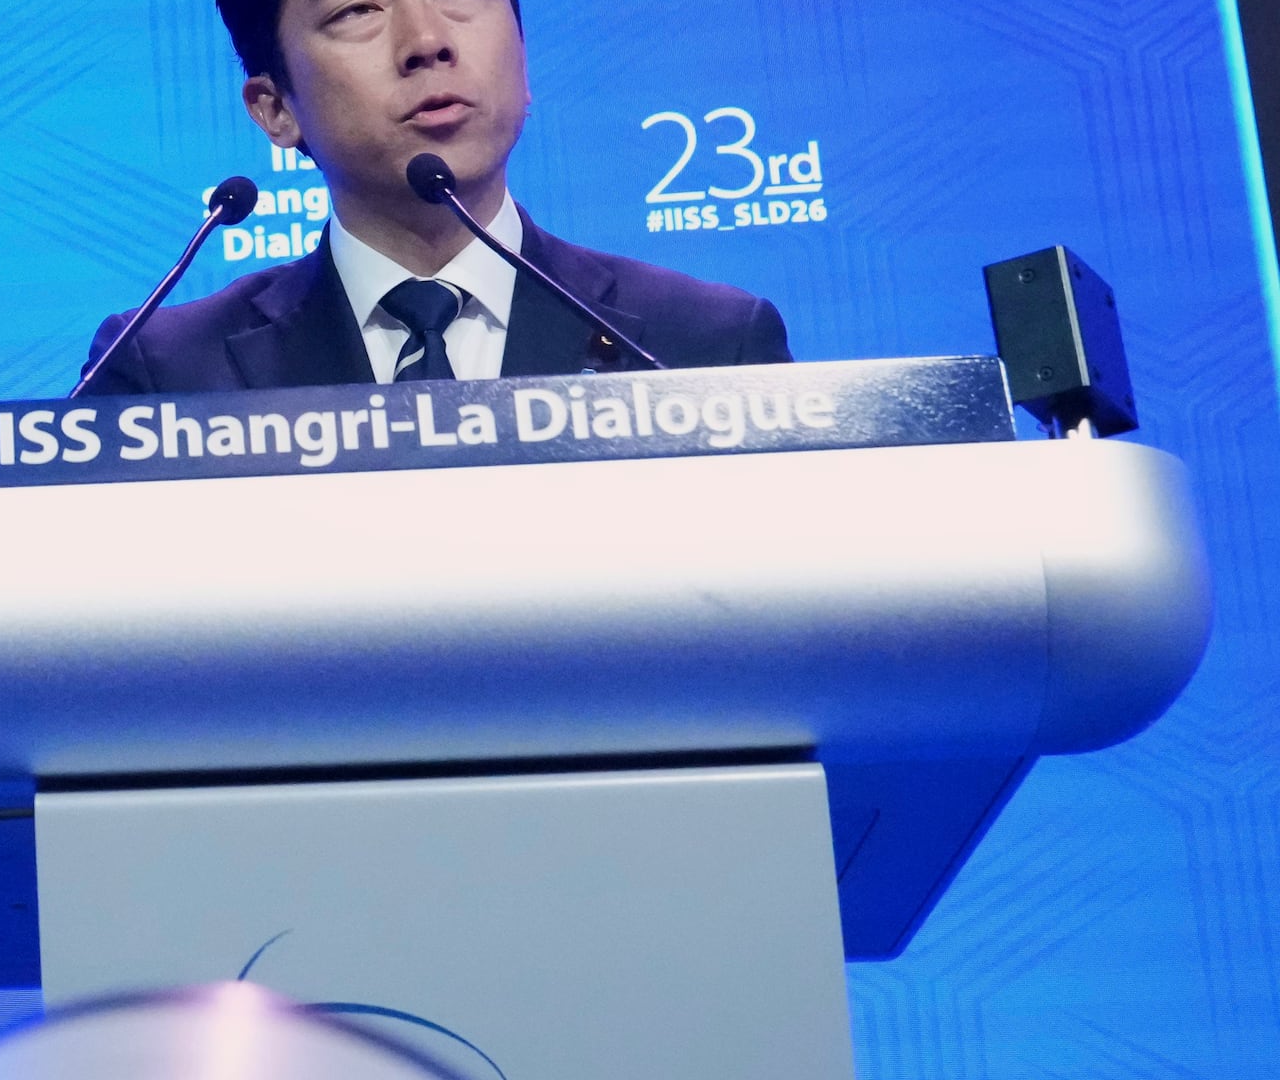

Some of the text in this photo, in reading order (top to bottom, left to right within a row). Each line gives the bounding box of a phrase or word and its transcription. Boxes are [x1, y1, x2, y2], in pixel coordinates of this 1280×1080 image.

[641, 107, 823, 203] 23rd
[645, 199, 828, 233] #IISS_SLD26
[118, 393, 498, 468] Shangri-La
[513, 381, 837, 448] Dialogue
